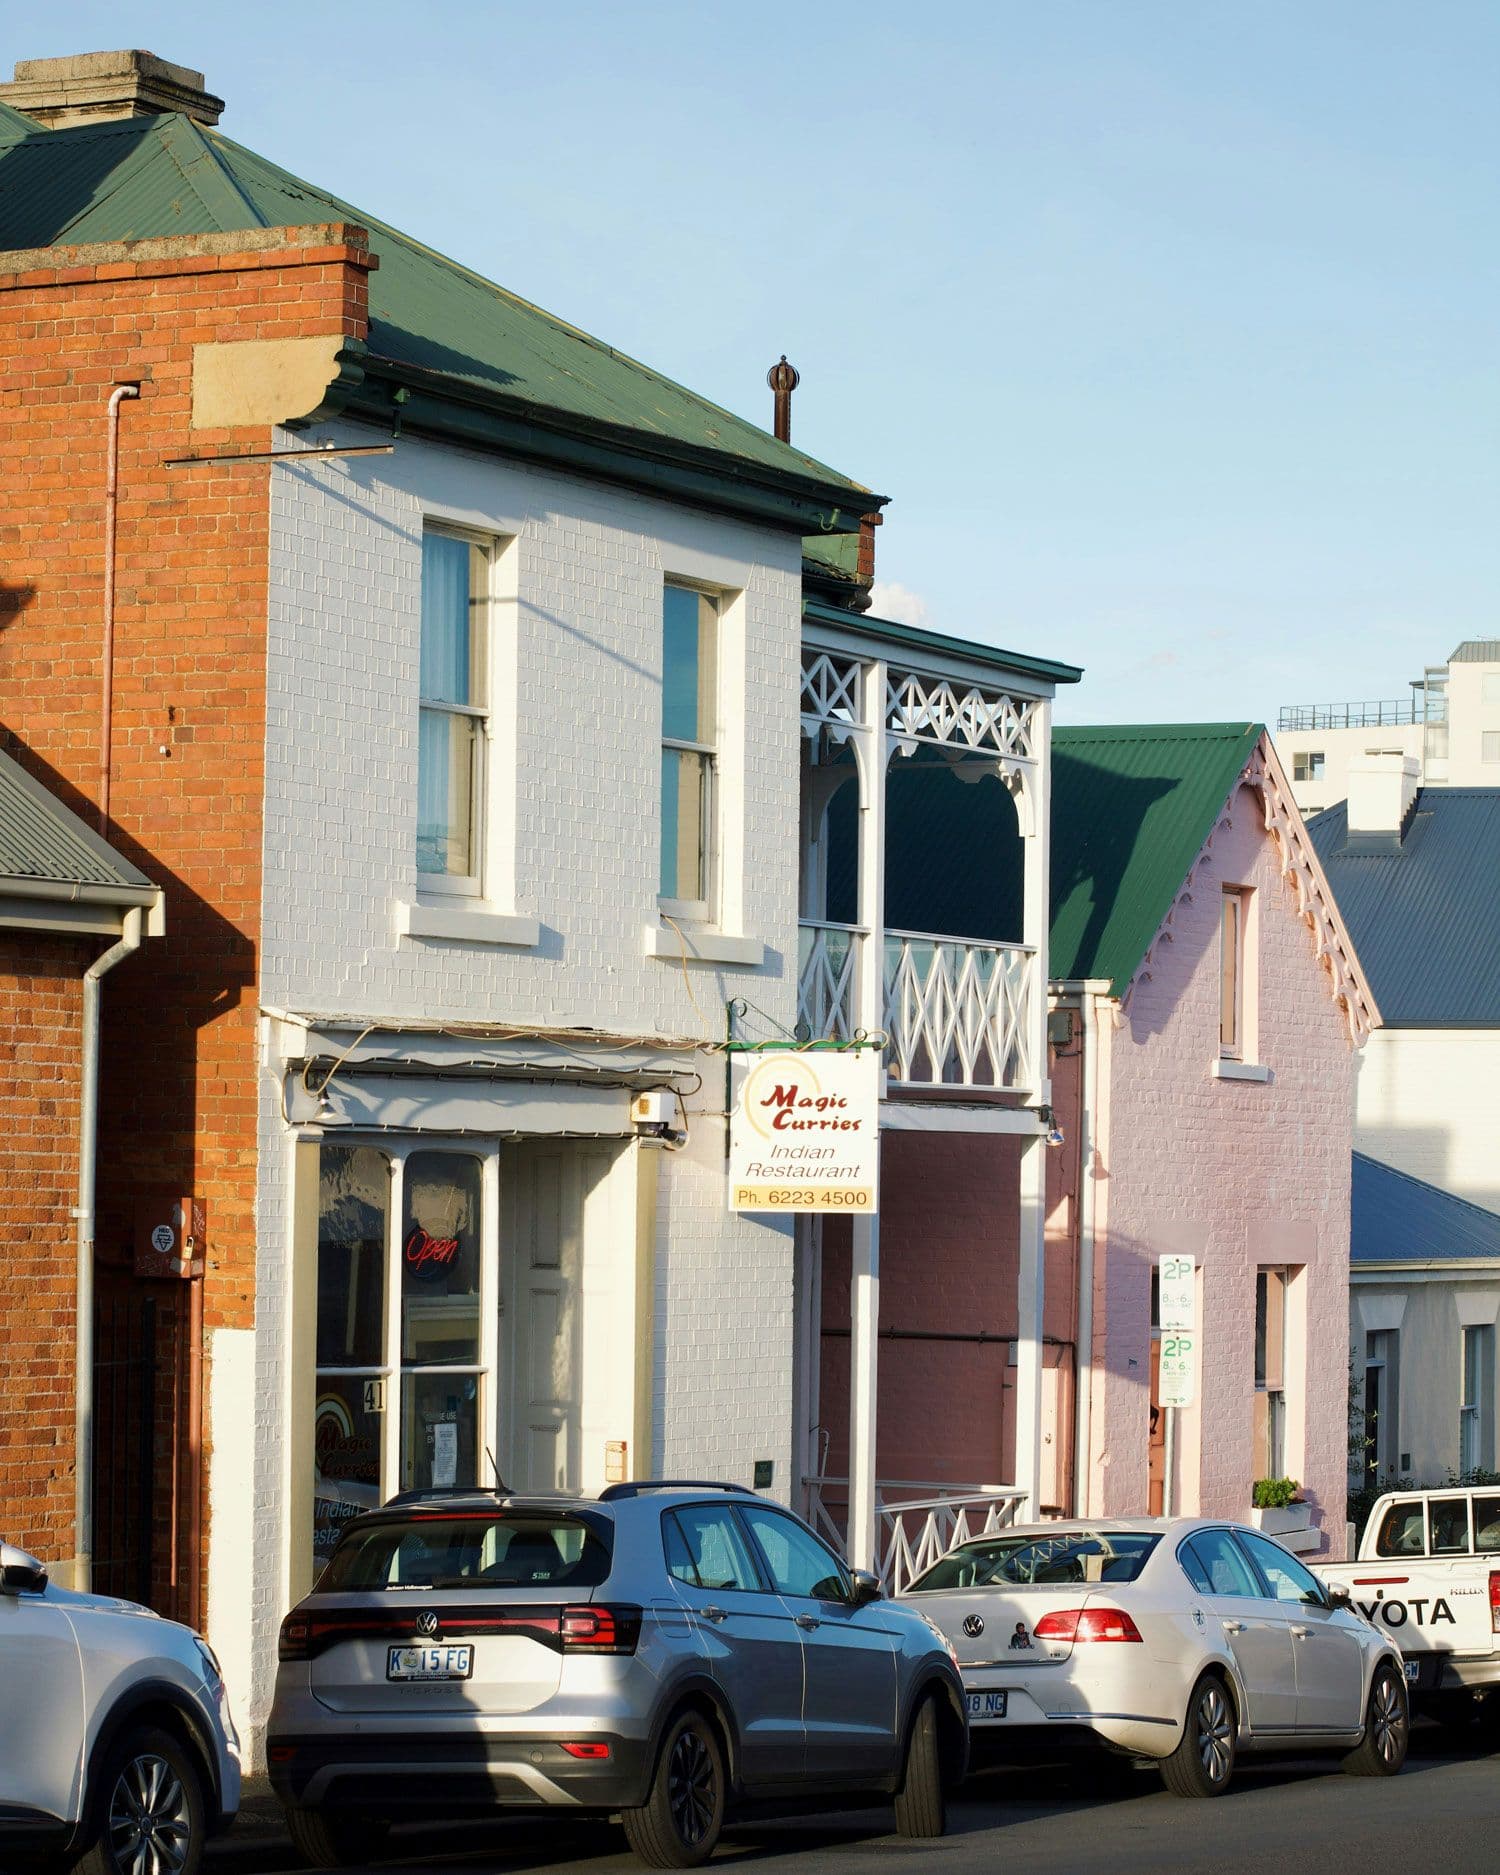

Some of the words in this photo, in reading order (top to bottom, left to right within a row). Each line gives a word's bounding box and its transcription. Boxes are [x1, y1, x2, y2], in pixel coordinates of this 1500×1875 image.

[760, 1084, 848, 1112] Magic
[772, 1108, 863, 1131] Curries
[770, 1144, 835, 1159] Indian
[745, 1162, 861, 1178] Restaurant
[738, 1190, 761, 1204] Ph.
[768, 1191, 815, 1204] 6223
[821, 1191, 867, 1205] 4500
[406, 1230, 459, 1271] Open
[1164, 1262, 1191, 1279] 2P
[1164, 1339, 1192, 1357] 2P
[363, 1382, 384, 1411] 41
[316, 1499, 360, 1518] Indian
[1349, 1598, 1456, 1627] YOTA
[986, 1694, 1003, 1711] NG
